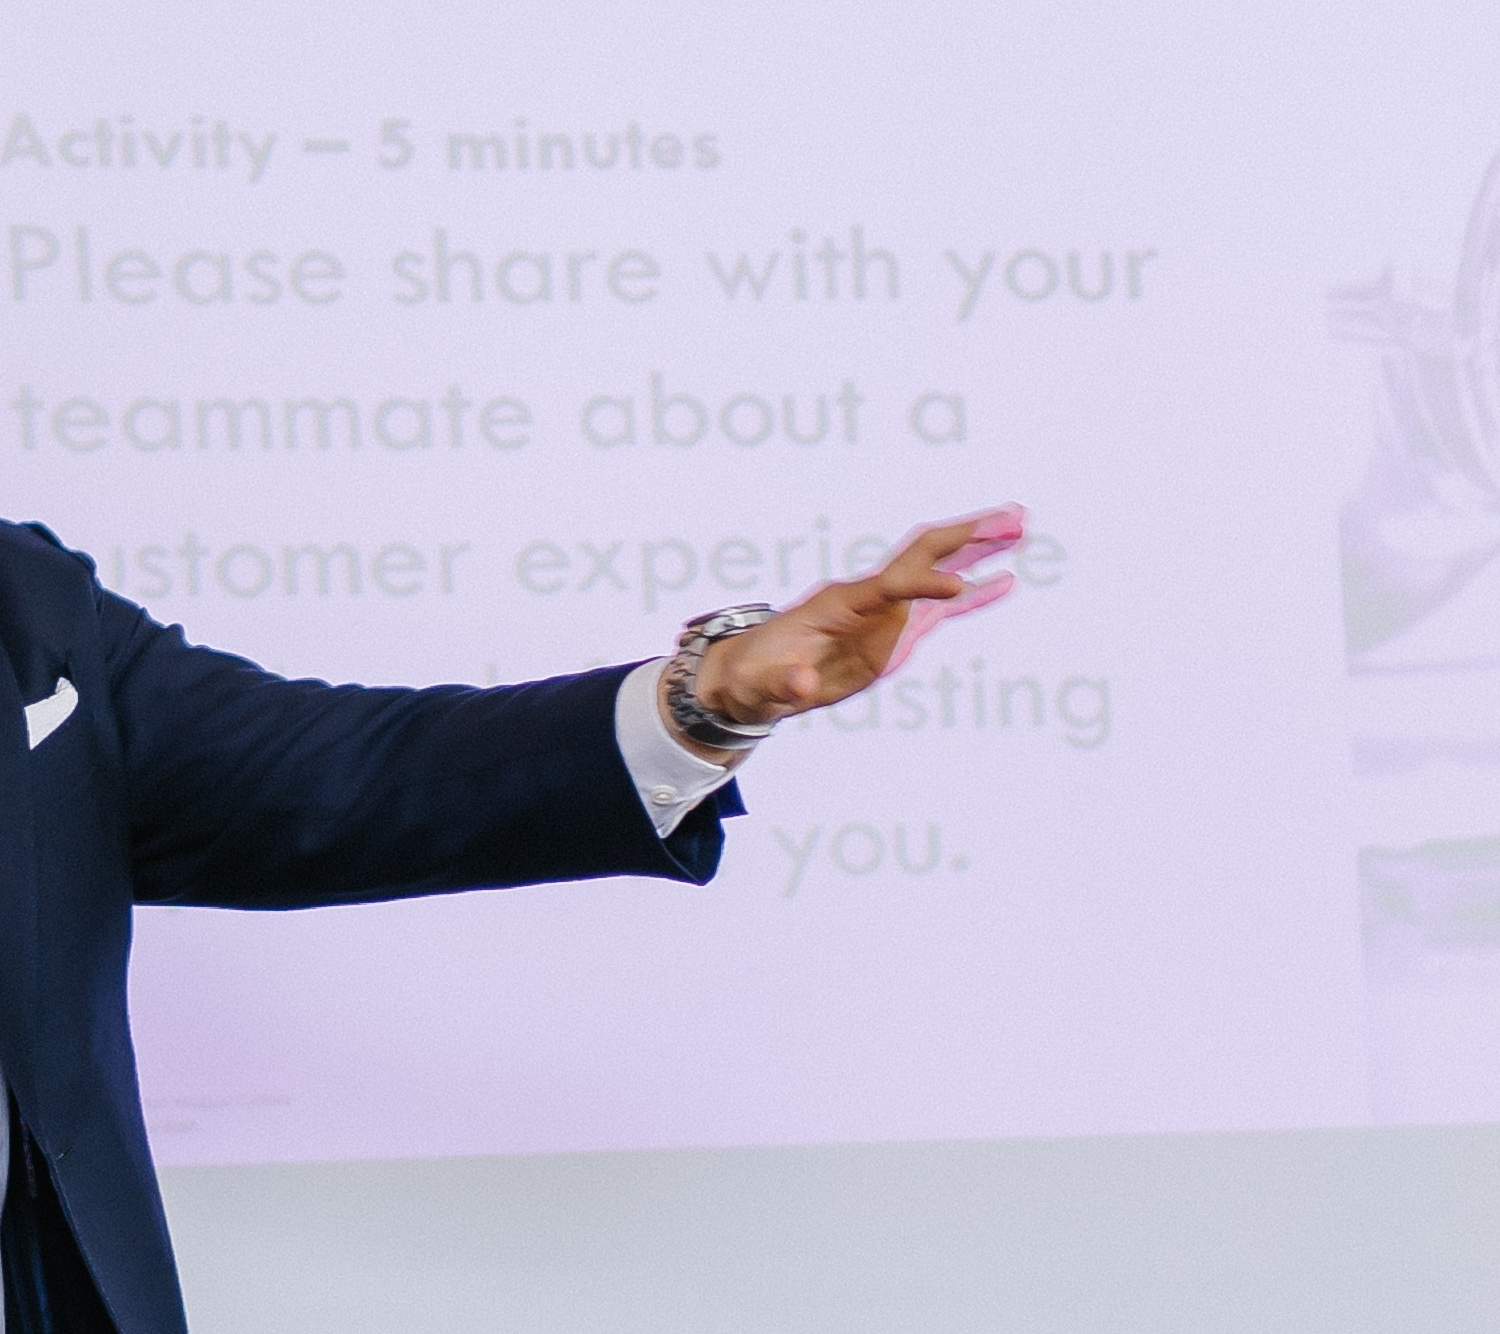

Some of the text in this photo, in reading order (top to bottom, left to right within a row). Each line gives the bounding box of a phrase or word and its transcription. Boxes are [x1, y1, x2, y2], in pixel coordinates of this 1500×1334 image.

[377, 117, 415, 171] 5
[443, 117, 723, 172] minutes
[5, 222, 1159, 324] Please share with your
[6, 369, 969, 457] teammate about a
[797, 654, 1113, 753] asting
[769, 819, 973, 901] you.
